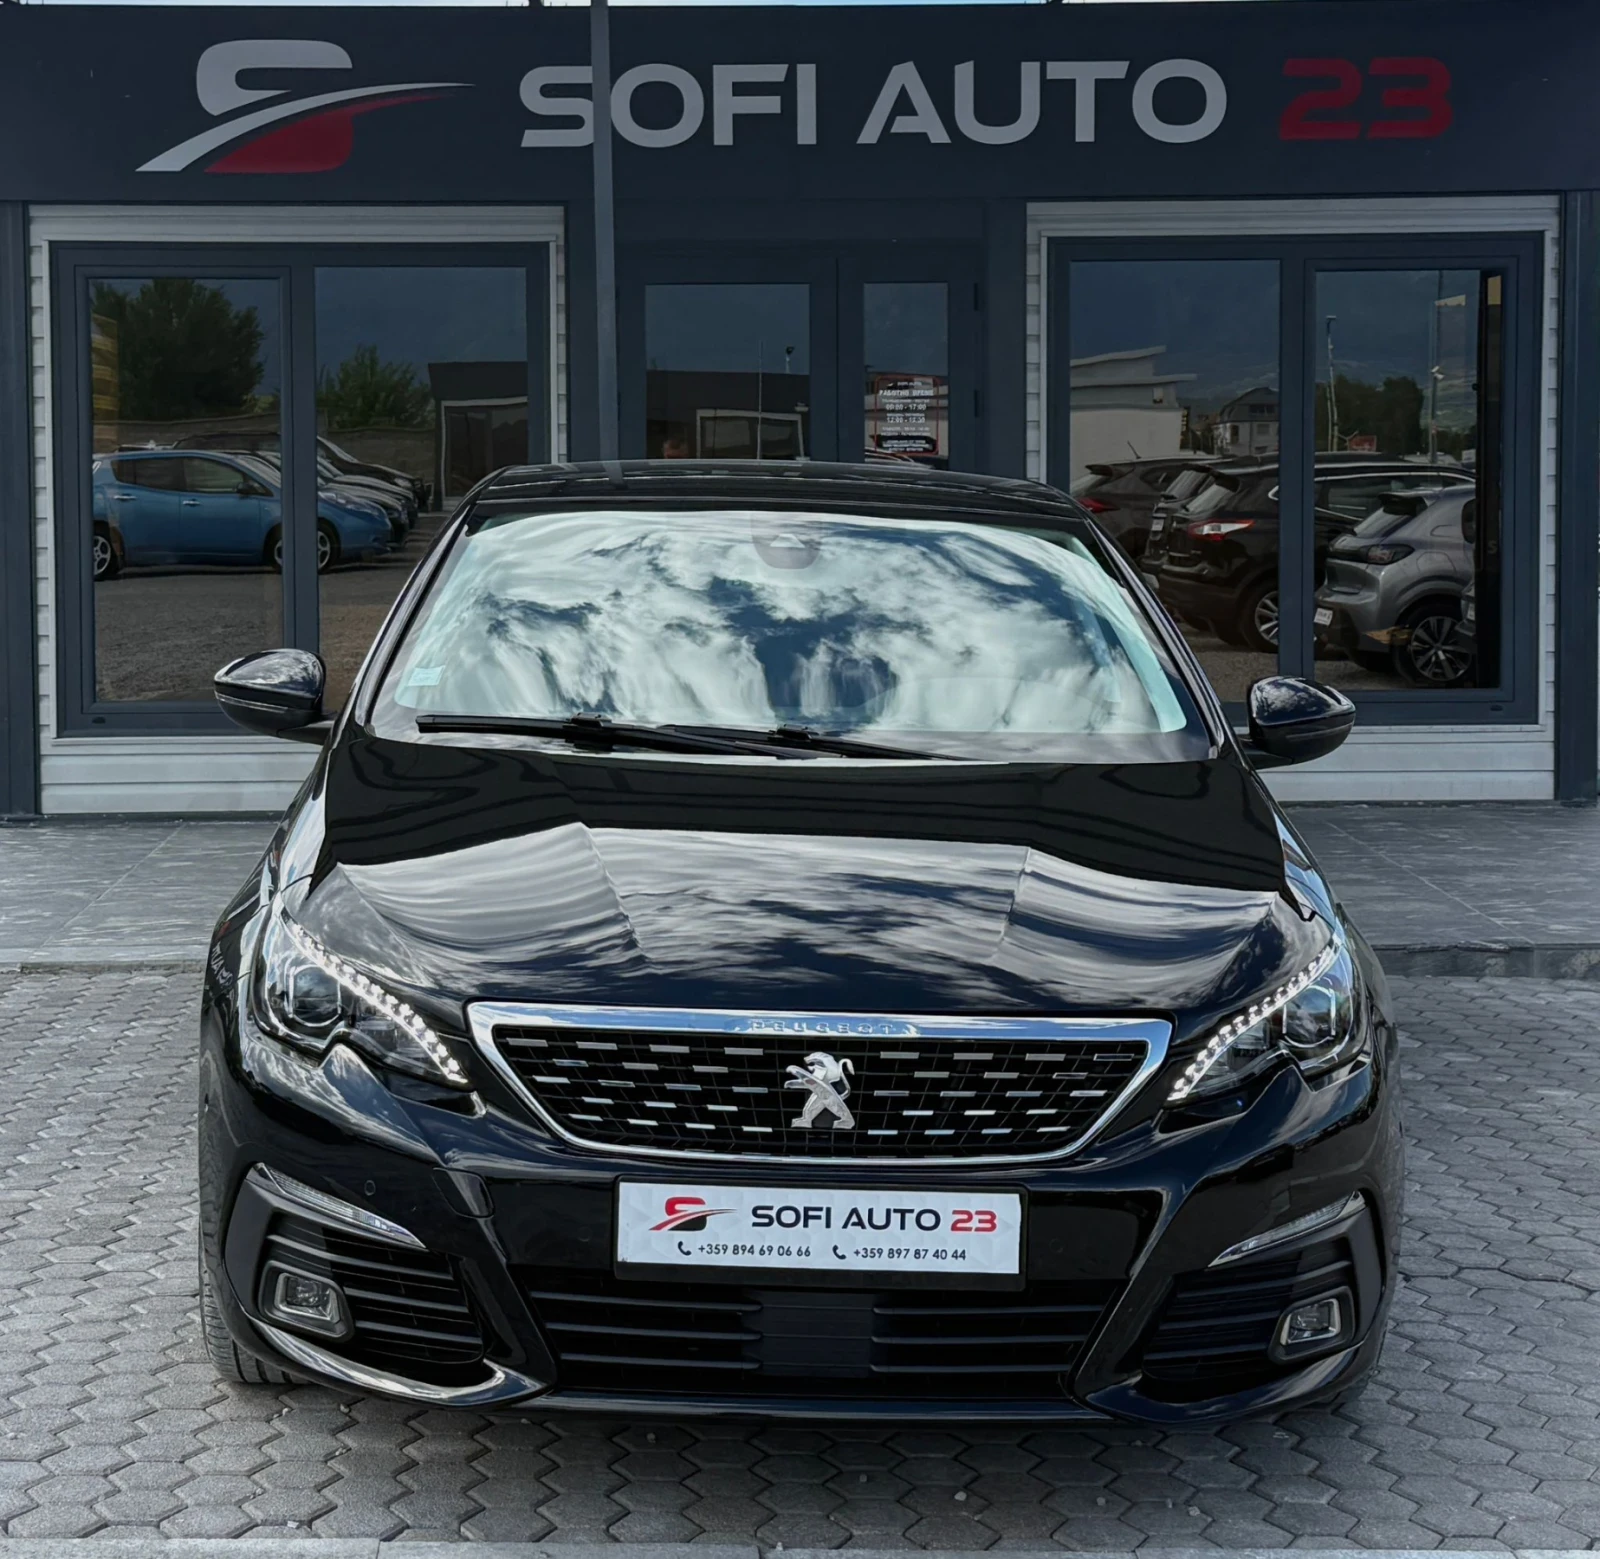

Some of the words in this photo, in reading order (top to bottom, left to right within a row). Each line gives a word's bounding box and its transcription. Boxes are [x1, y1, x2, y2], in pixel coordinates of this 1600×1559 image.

[519, 63, 817, 148] SOFI
[856, 59, 1227, 147] AUTO
[1279, 57, 1453, 140] 23
[751, 1020, 893, 1034] PEUGEOT
[751, 1205, 832, 1229] SOFI
[842, 1206, 941, 1231] AUTO
[951, 1209, 997, 1232] 23
[698, 1243, 729, 1255] +359
[732, 1244, 755, 1256] 894
[759, 1245, 774, 1256] 69
[777, 1245, 793, 1256] 06
[796, 1246, 811, 1257] 66
[853, 1247, 884, 1259] +359
[887, 1248, 910, 1259] 897
[913, 1248, 929, 1260] 87
[932, 1249, 948, 1260] 40
[951, 1249, 967, 1260] 44
